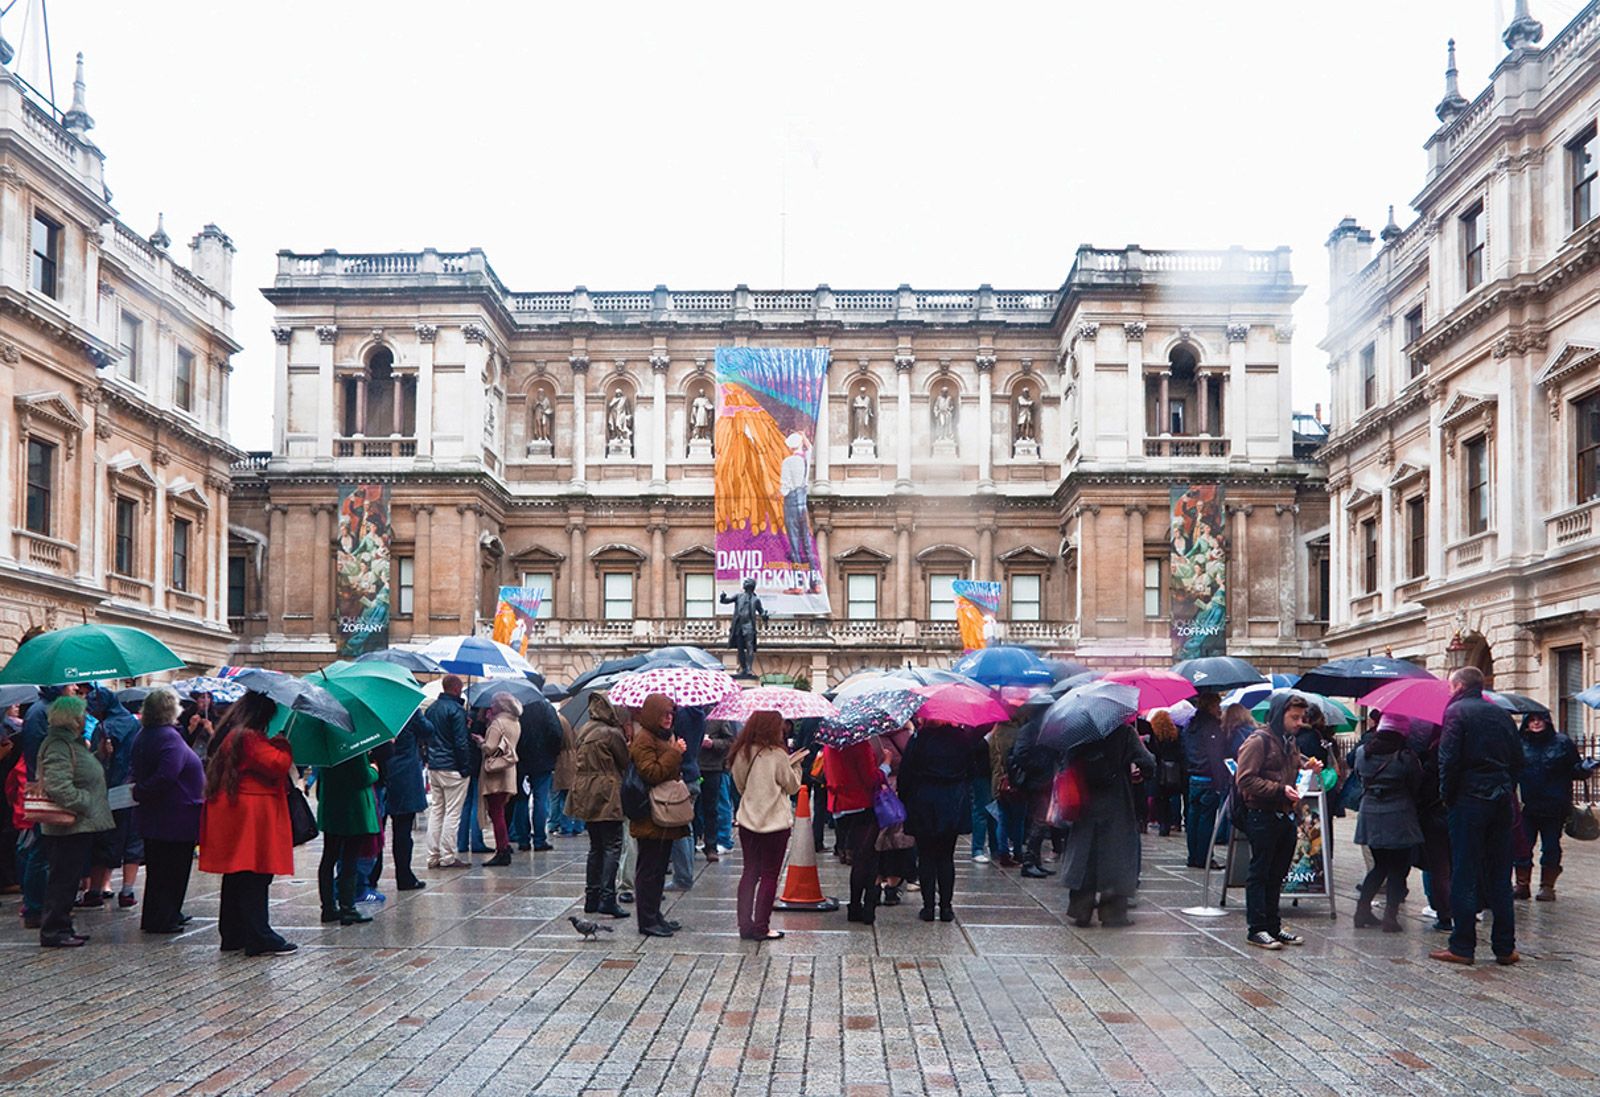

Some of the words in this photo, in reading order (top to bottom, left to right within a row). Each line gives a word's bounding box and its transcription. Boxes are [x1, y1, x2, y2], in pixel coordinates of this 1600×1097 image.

[716, 549, 763, 570] DAVID
[342, 623, 384, 633] ZOFFANY
[1176, 627, 1219, 637] ZOFFANY
[1283, 871, 1317, 883] FANY
